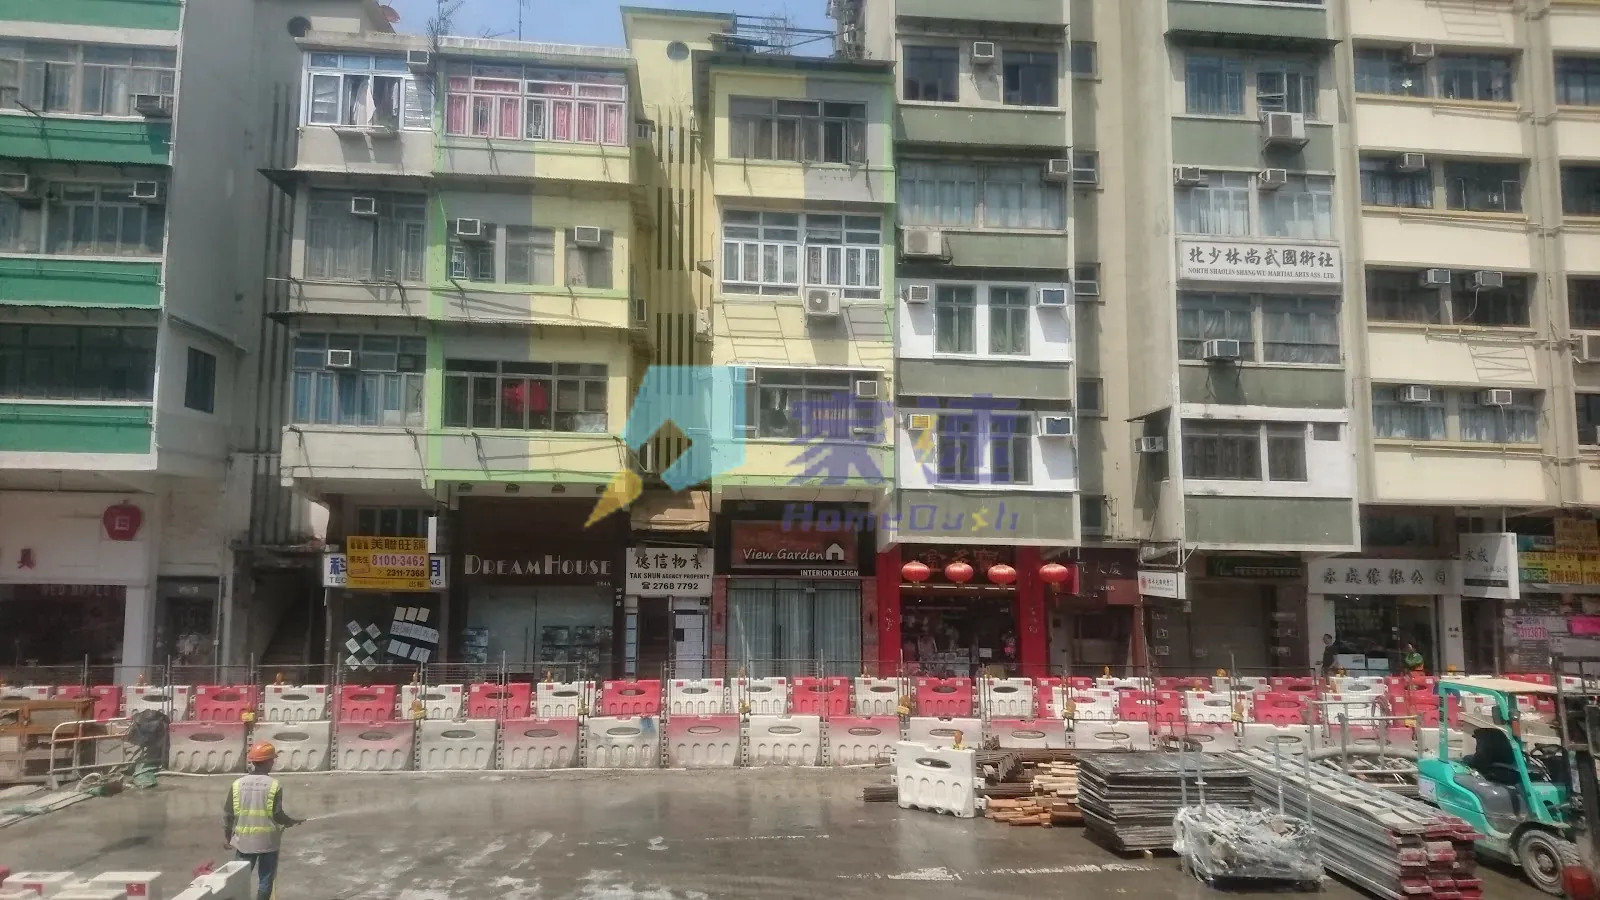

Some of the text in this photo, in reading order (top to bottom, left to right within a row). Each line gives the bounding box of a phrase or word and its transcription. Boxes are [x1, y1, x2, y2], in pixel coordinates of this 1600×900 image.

[1188, 246, 1334, 267] 北少林尚武國術社
[743, 548, 824, 560] View Garden
[800, 569, 859, 577] INTERIOR DESIGN
[653, 582, 699, 590] 2768 7792
